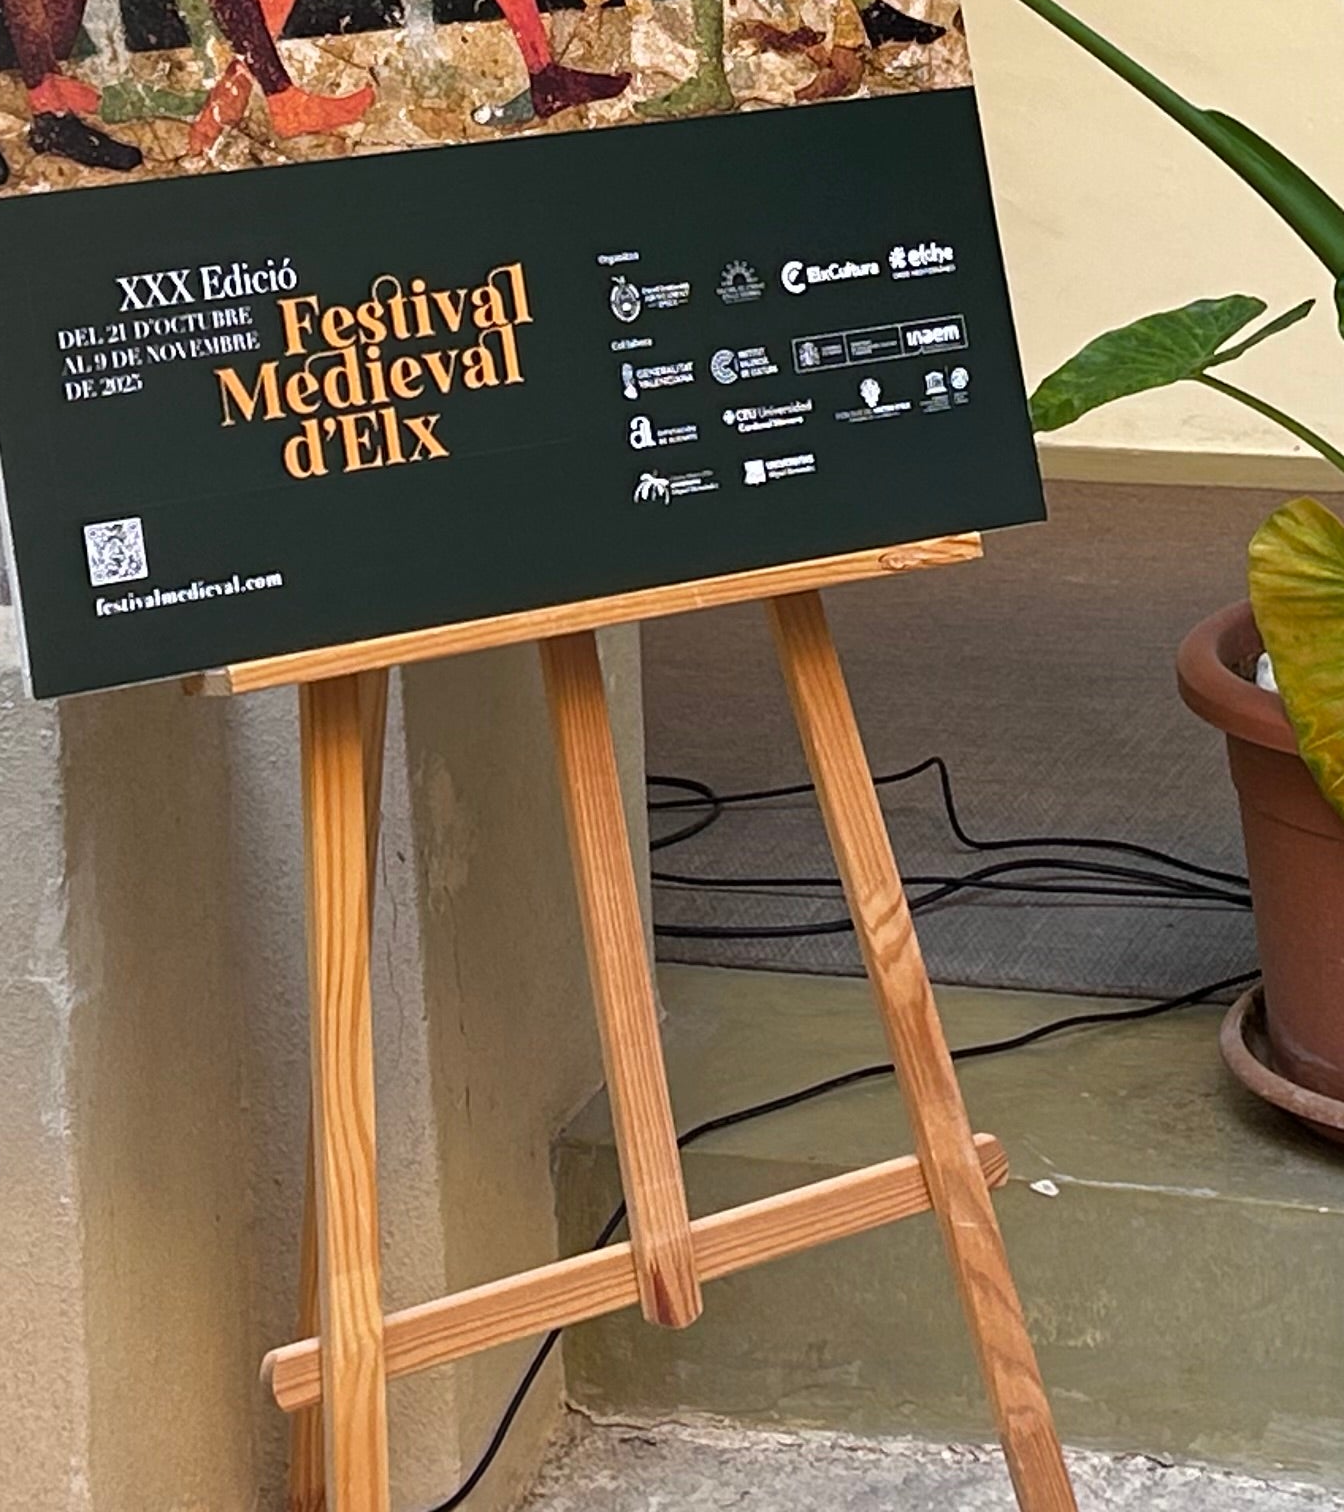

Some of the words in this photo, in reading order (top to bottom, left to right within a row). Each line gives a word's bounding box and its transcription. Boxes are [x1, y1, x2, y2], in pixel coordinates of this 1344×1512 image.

[907, 241, 954, 267] elche
[115, 268, 196, 312] XXX
[200, 257, 298, 302] Edició
[277, 261, 533, 357] Festival
[57, 326, 104, 350] DEL
[106, 321, 127, 343] 21
[62, 354, 93, 376] AL
[94, 352, 107, 371] 9
[111, 347, 143, 369] DE
[147, 331, 260, 364] NOVEMBRE
[64, 379, 97, 402] DE
[99, 373, 143, 396] 2025
[213, 324, 525, 427] Medieval
[283, 407, 450, 480] d'Elx
[95, 570, 284, 617] festivalmedieval.com
